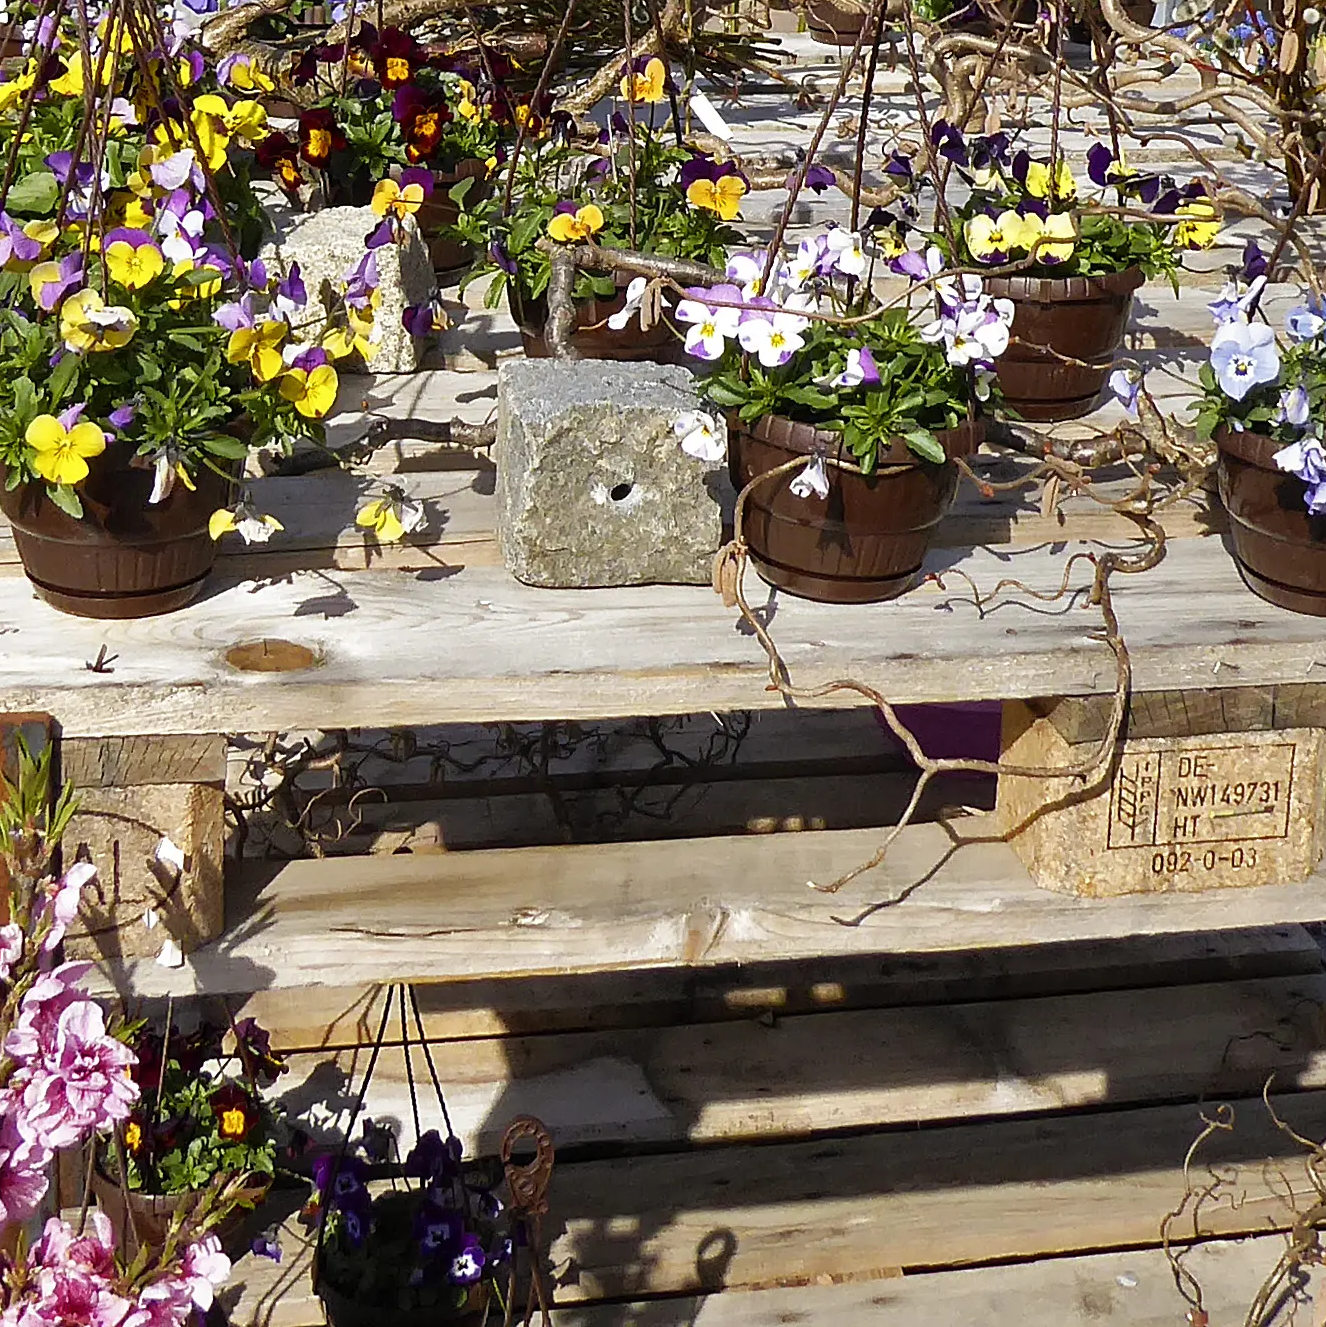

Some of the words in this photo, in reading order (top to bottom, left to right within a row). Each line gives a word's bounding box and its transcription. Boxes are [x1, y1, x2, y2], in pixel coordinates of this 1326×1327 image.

[1178, 755, 1216, 779] DE-
[1176, 780, 1280, 810] NW149731
[1173, 814, 1201, 838] HT
[1151, 847, 1258, 874] 092-0-03
